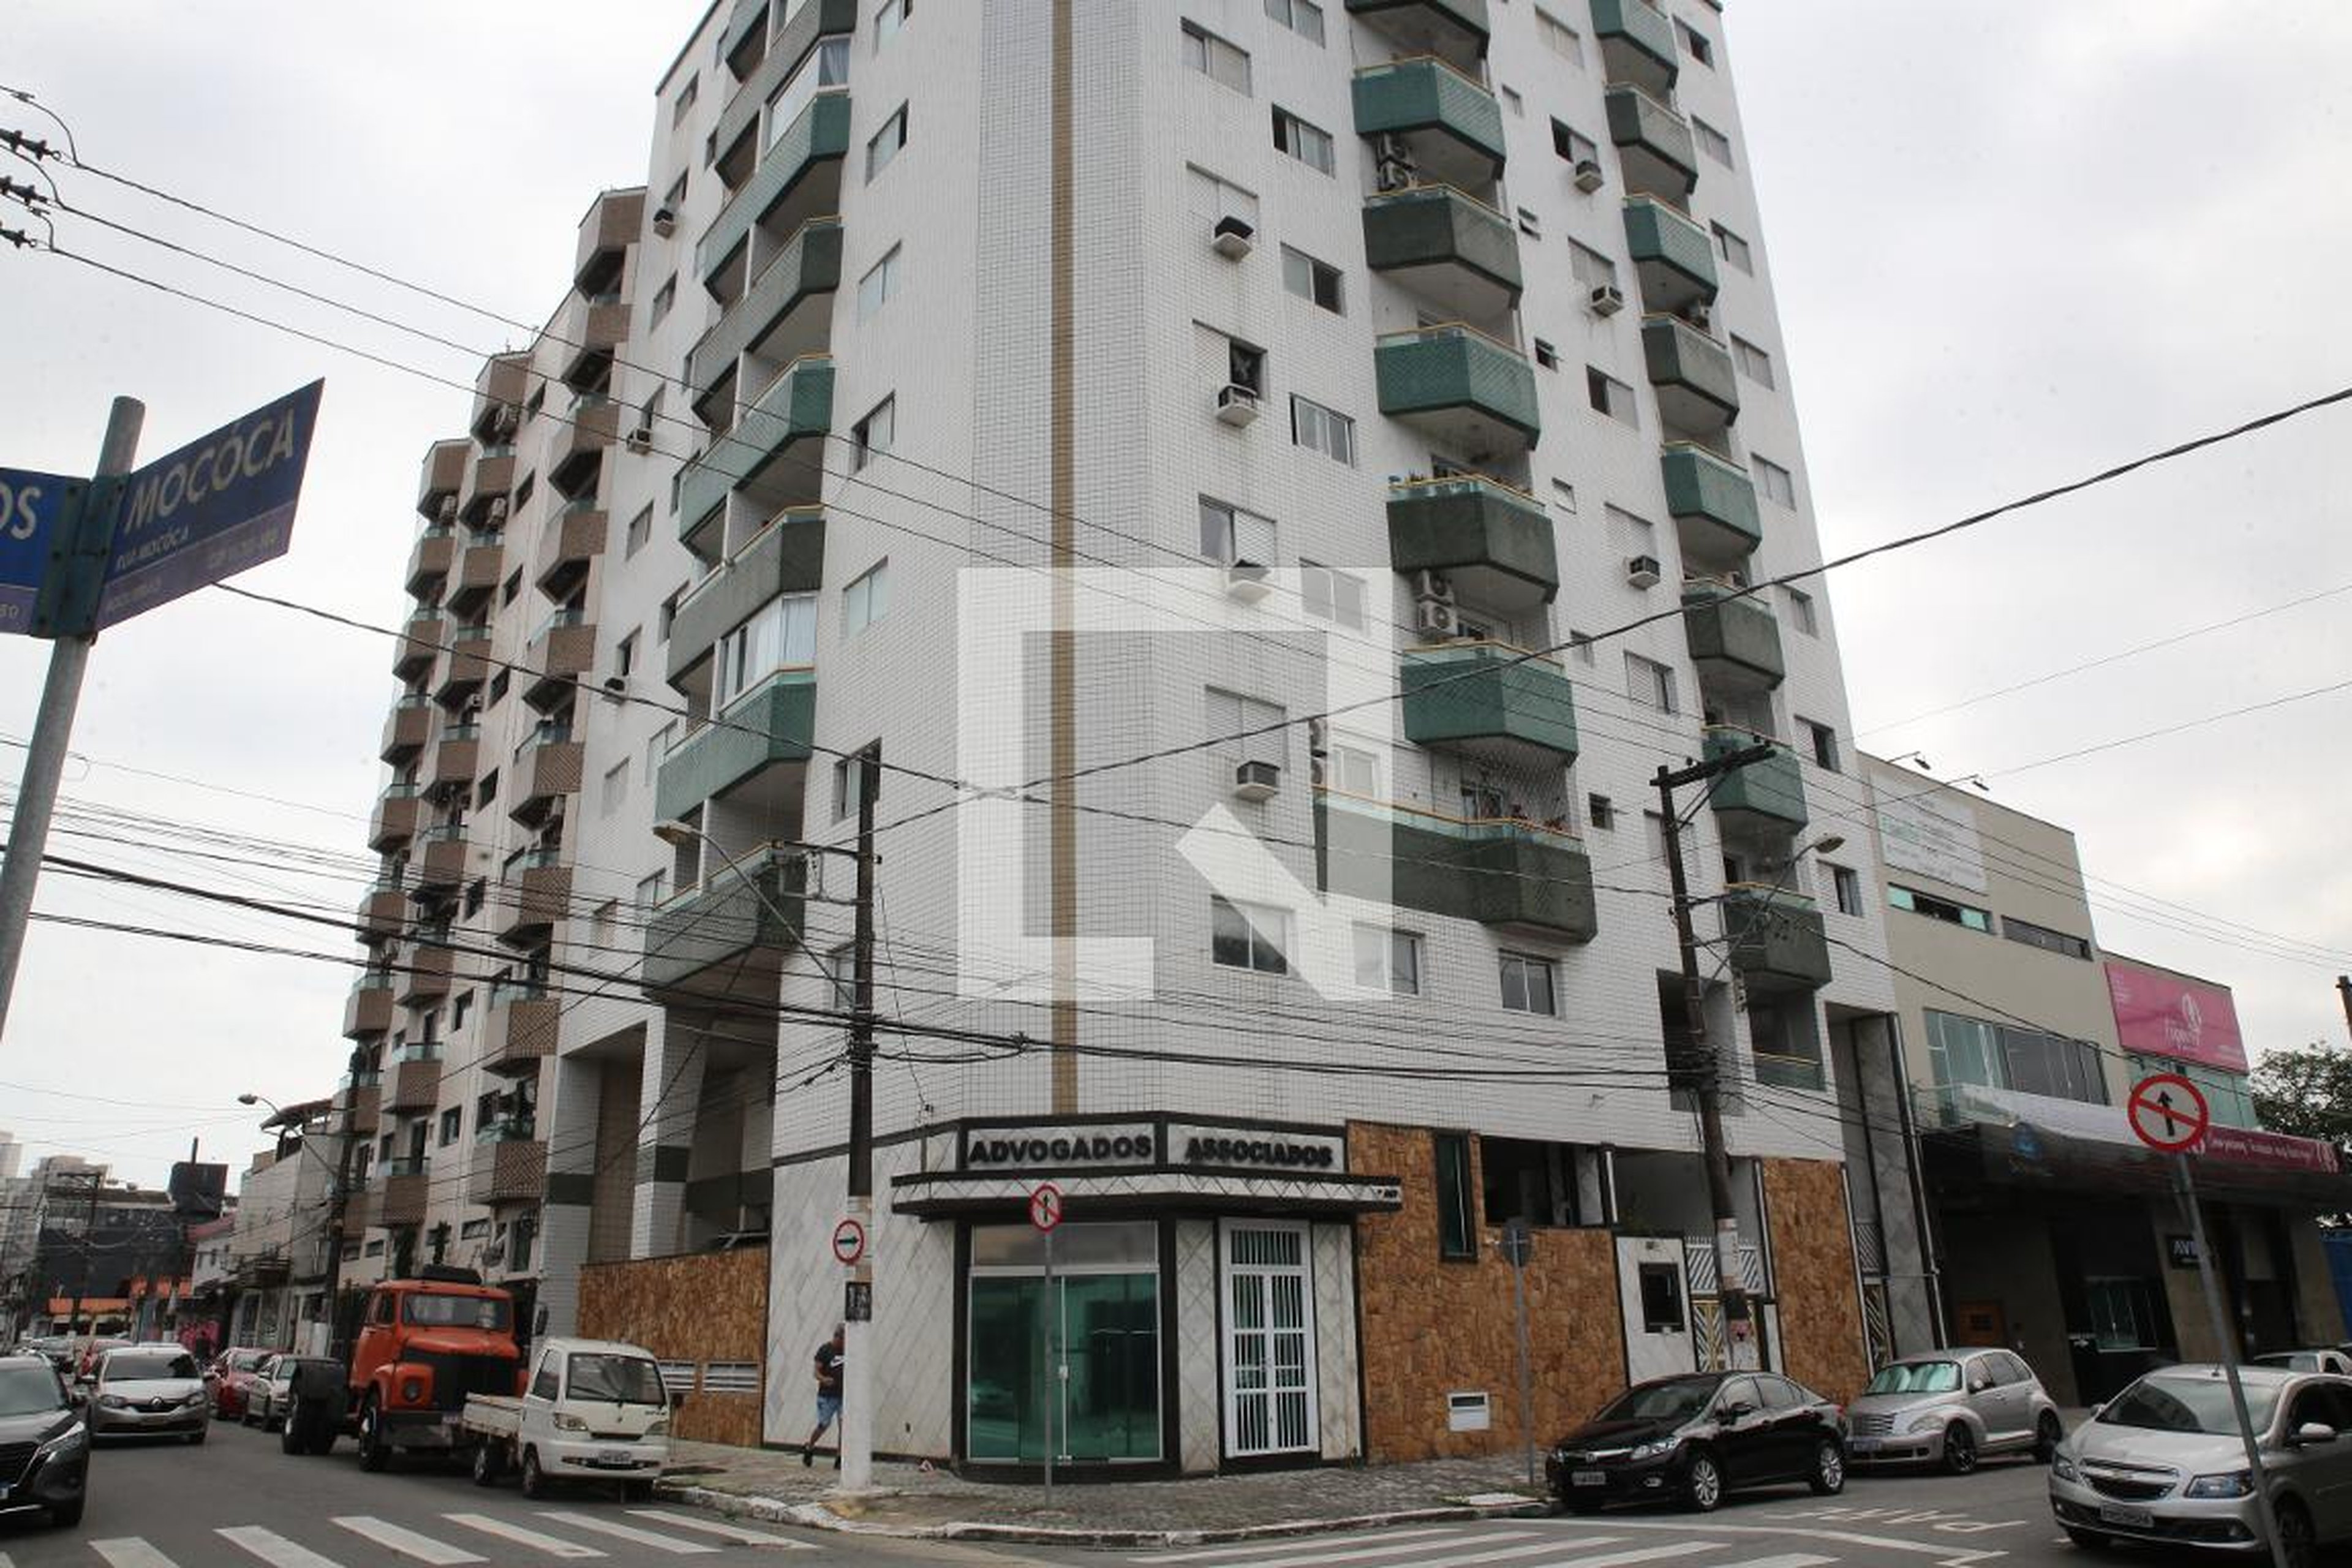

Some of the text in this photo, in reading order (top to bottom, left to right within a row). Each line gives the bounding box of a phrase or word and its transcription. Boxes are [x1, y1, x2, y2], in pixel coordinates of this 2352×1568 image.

[124, 407, 296, 535] MOCÓCA
[968, 1135, 1333, 1167] ADVOGADOS ASSOCIADOS
